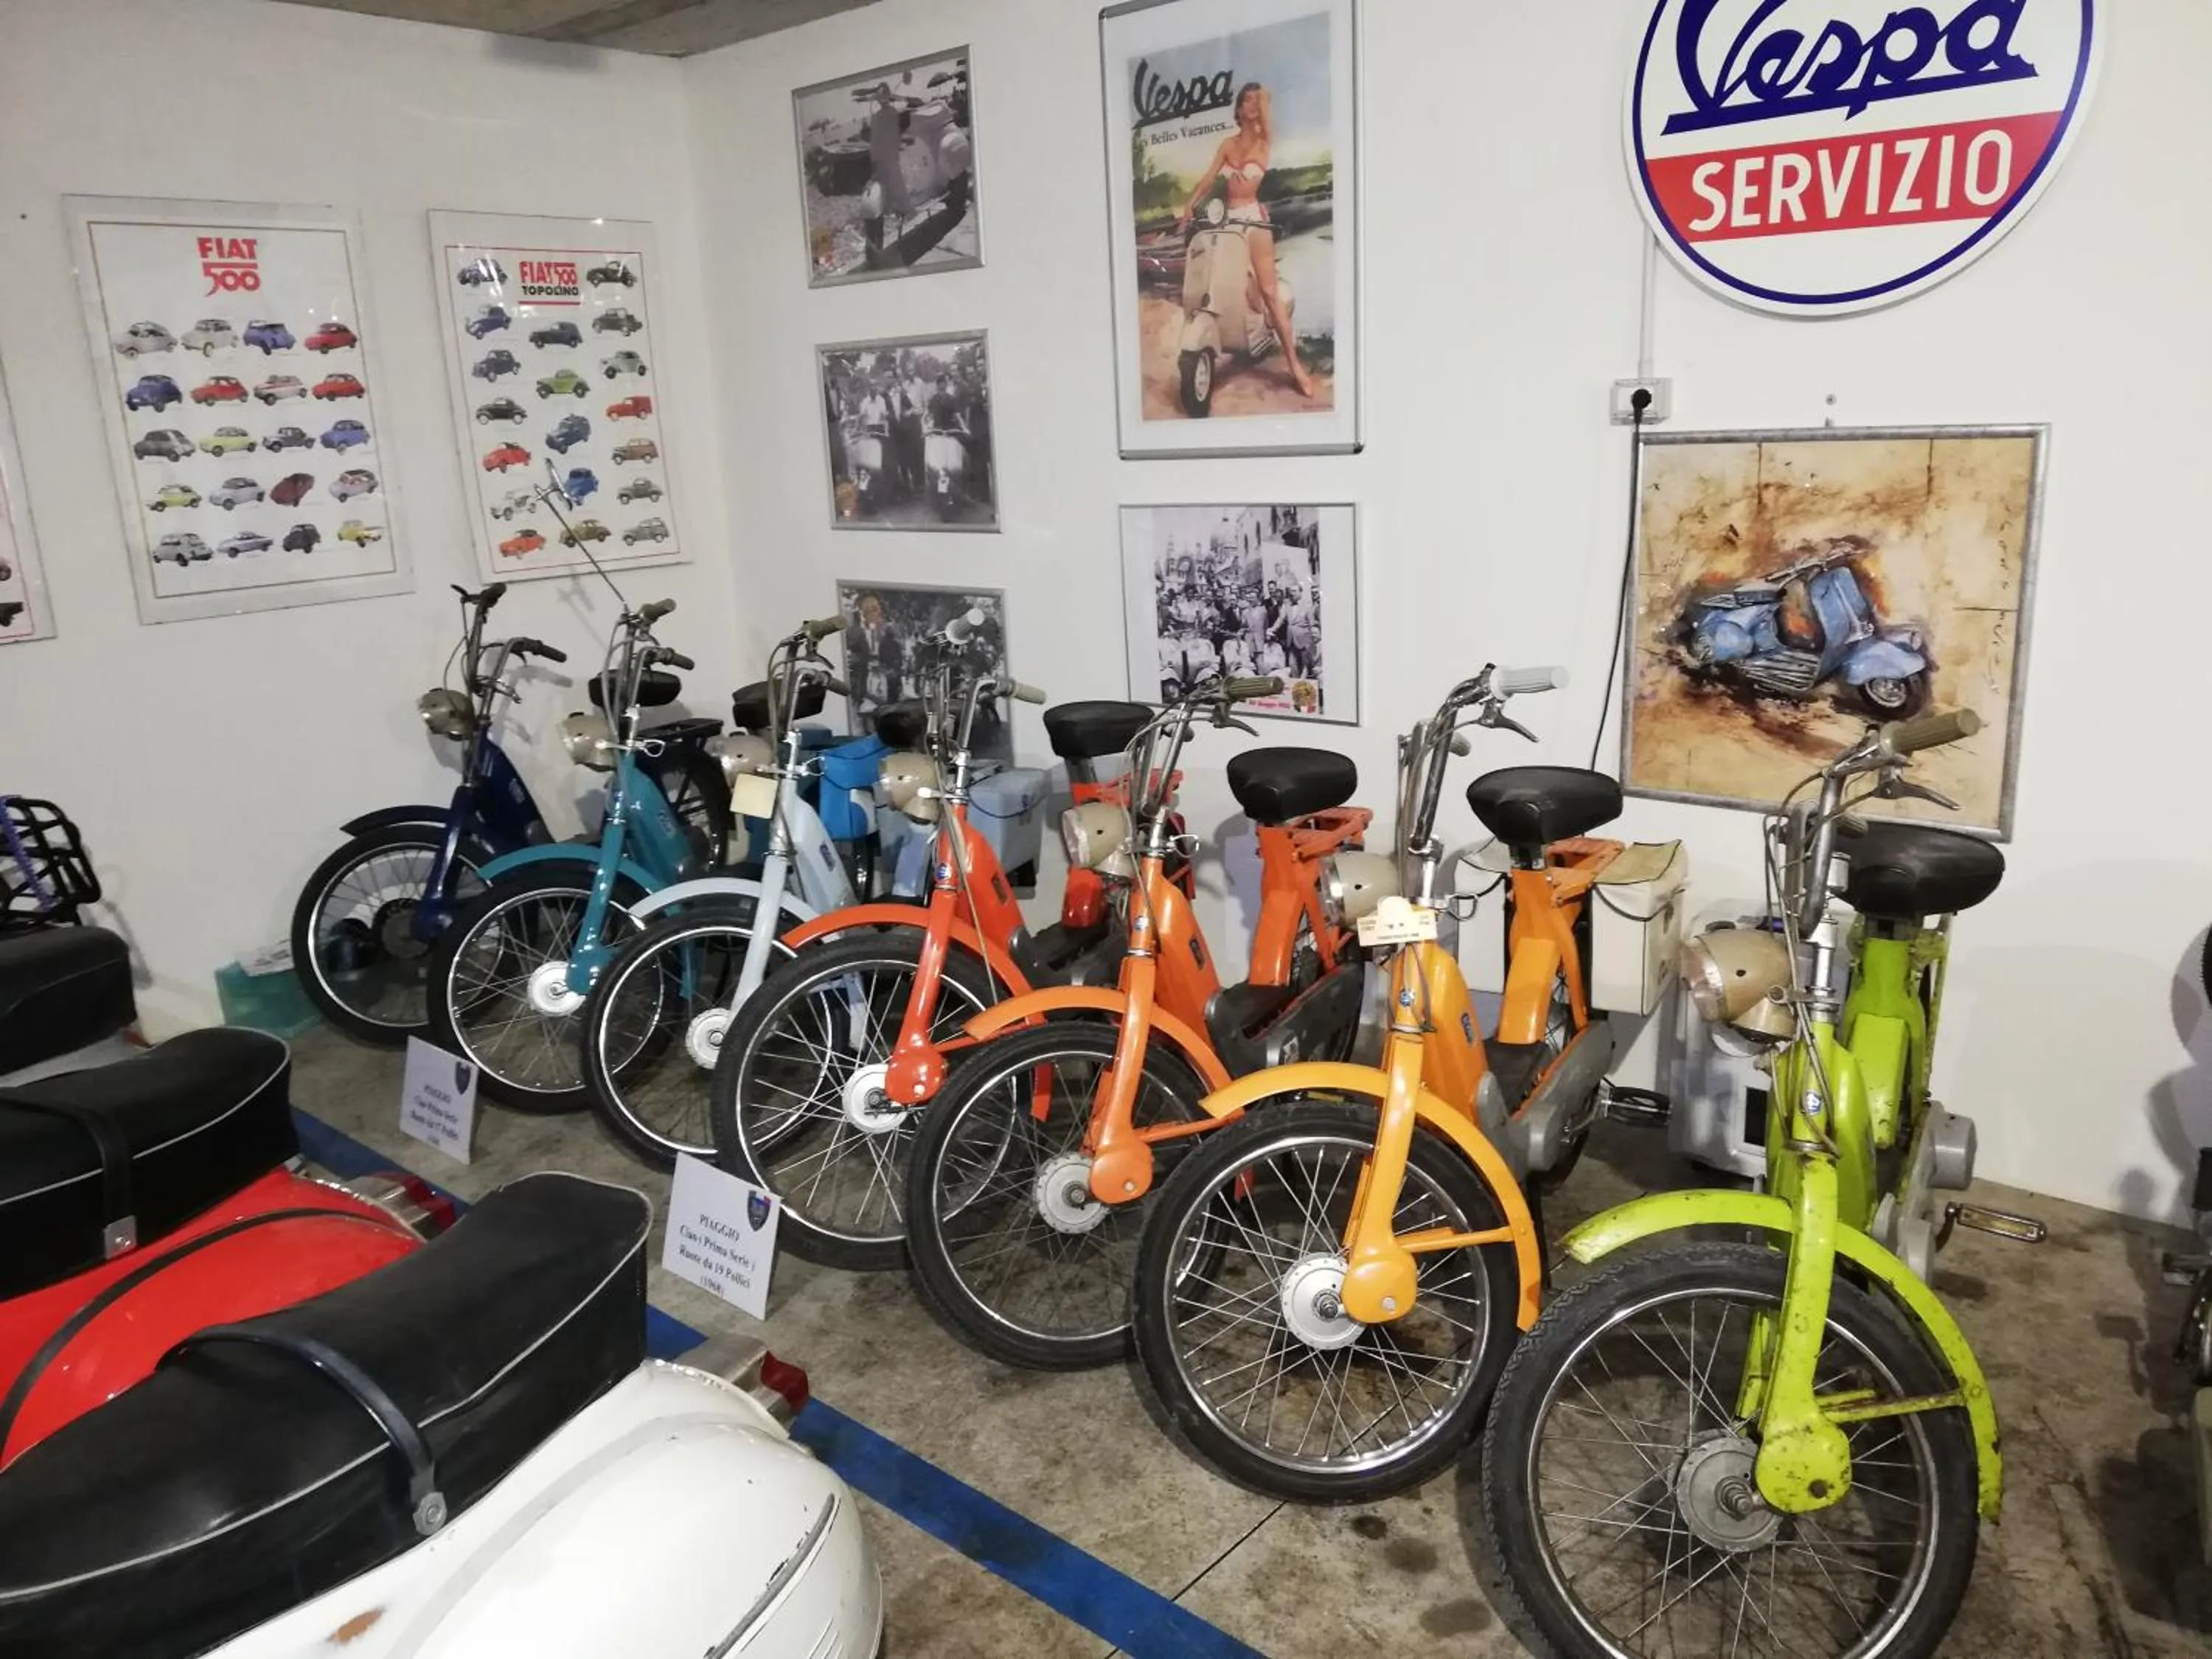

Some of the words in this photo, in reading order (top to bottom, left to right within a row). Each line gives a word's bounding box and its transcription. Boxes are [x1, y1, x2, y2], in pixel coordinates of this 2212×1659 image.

[1133, 58, 1234, 130] Vespa
[1660, 0, 2039, 136] Vespa
[1688, 129, 2013, 232] SERVIZIO
[197, 237, 258, 260] FIAT
[202, 262, 260, 297] 500
[521, 285, 579, 296] TOPOLINO
